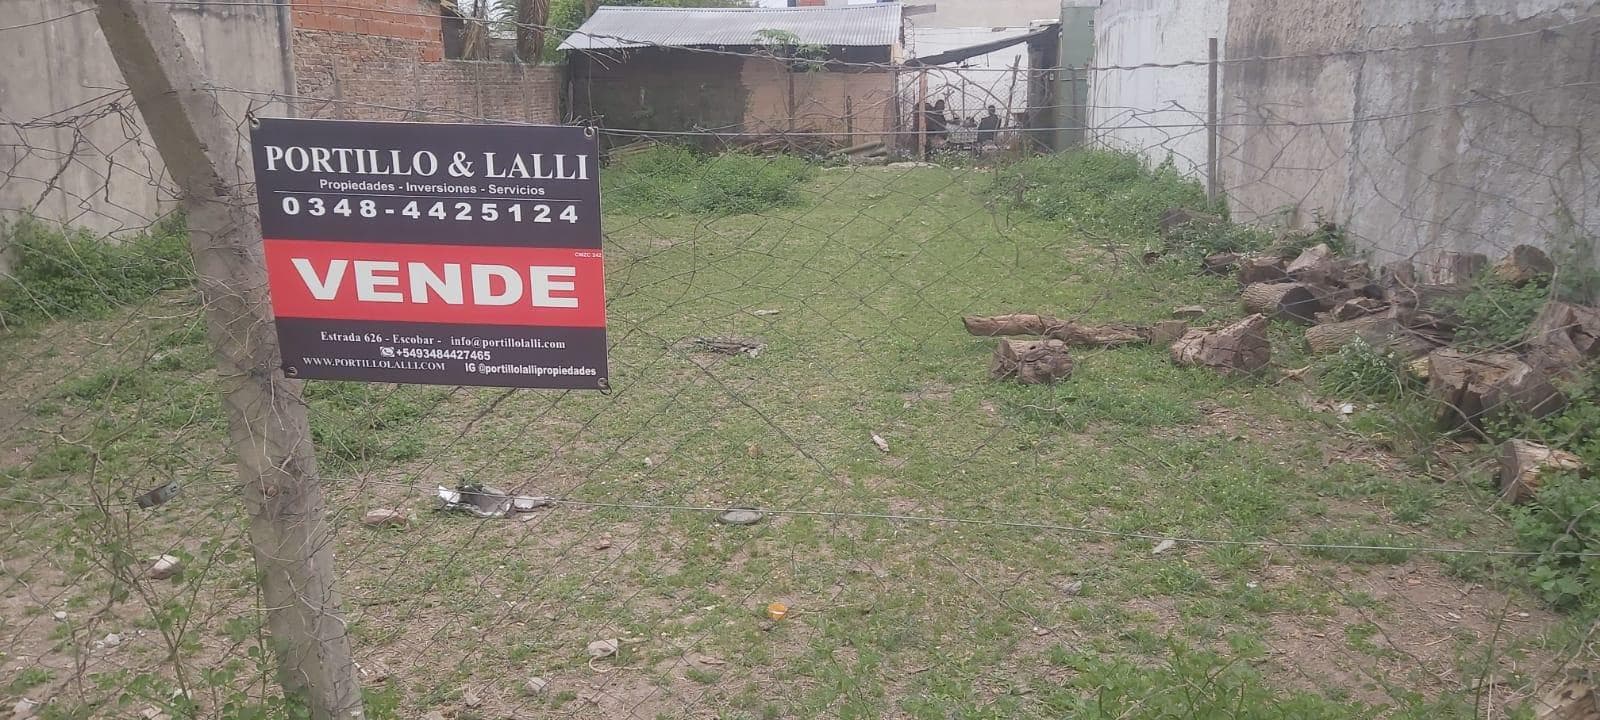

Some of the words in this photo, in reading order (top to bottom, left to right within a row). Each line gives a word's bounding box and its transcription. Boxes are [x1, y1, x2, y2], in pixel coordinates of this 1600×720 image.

[264, 145, 438, 176] PORTILLO
[448, 151, 475, 177] &
[483, 152, 589, 180] LALLI
[320, 178, 395, 192] Propiedades
[406, 182, 476, 194] Inversiones
[488, 184, 545, 196] Servicios
[281, 196, 578, 224] 0348-4425124
[291, 258, 579, 308] VENDE
[320, 331, 361, 342] Estrada
[364, 333, 382, 343] 626
[392, 334, 434, 345] Escobar
[450, 336, 566, 349] info@portillolalli.com
[396, 348, 491, 361] +5493484427465
[302, 357, 446, 371] WWW.PORTILLOLALLI.COM
[465, 362, 476, 373] IG
[478, 364, 597, 377] @portillolallipropiedades
